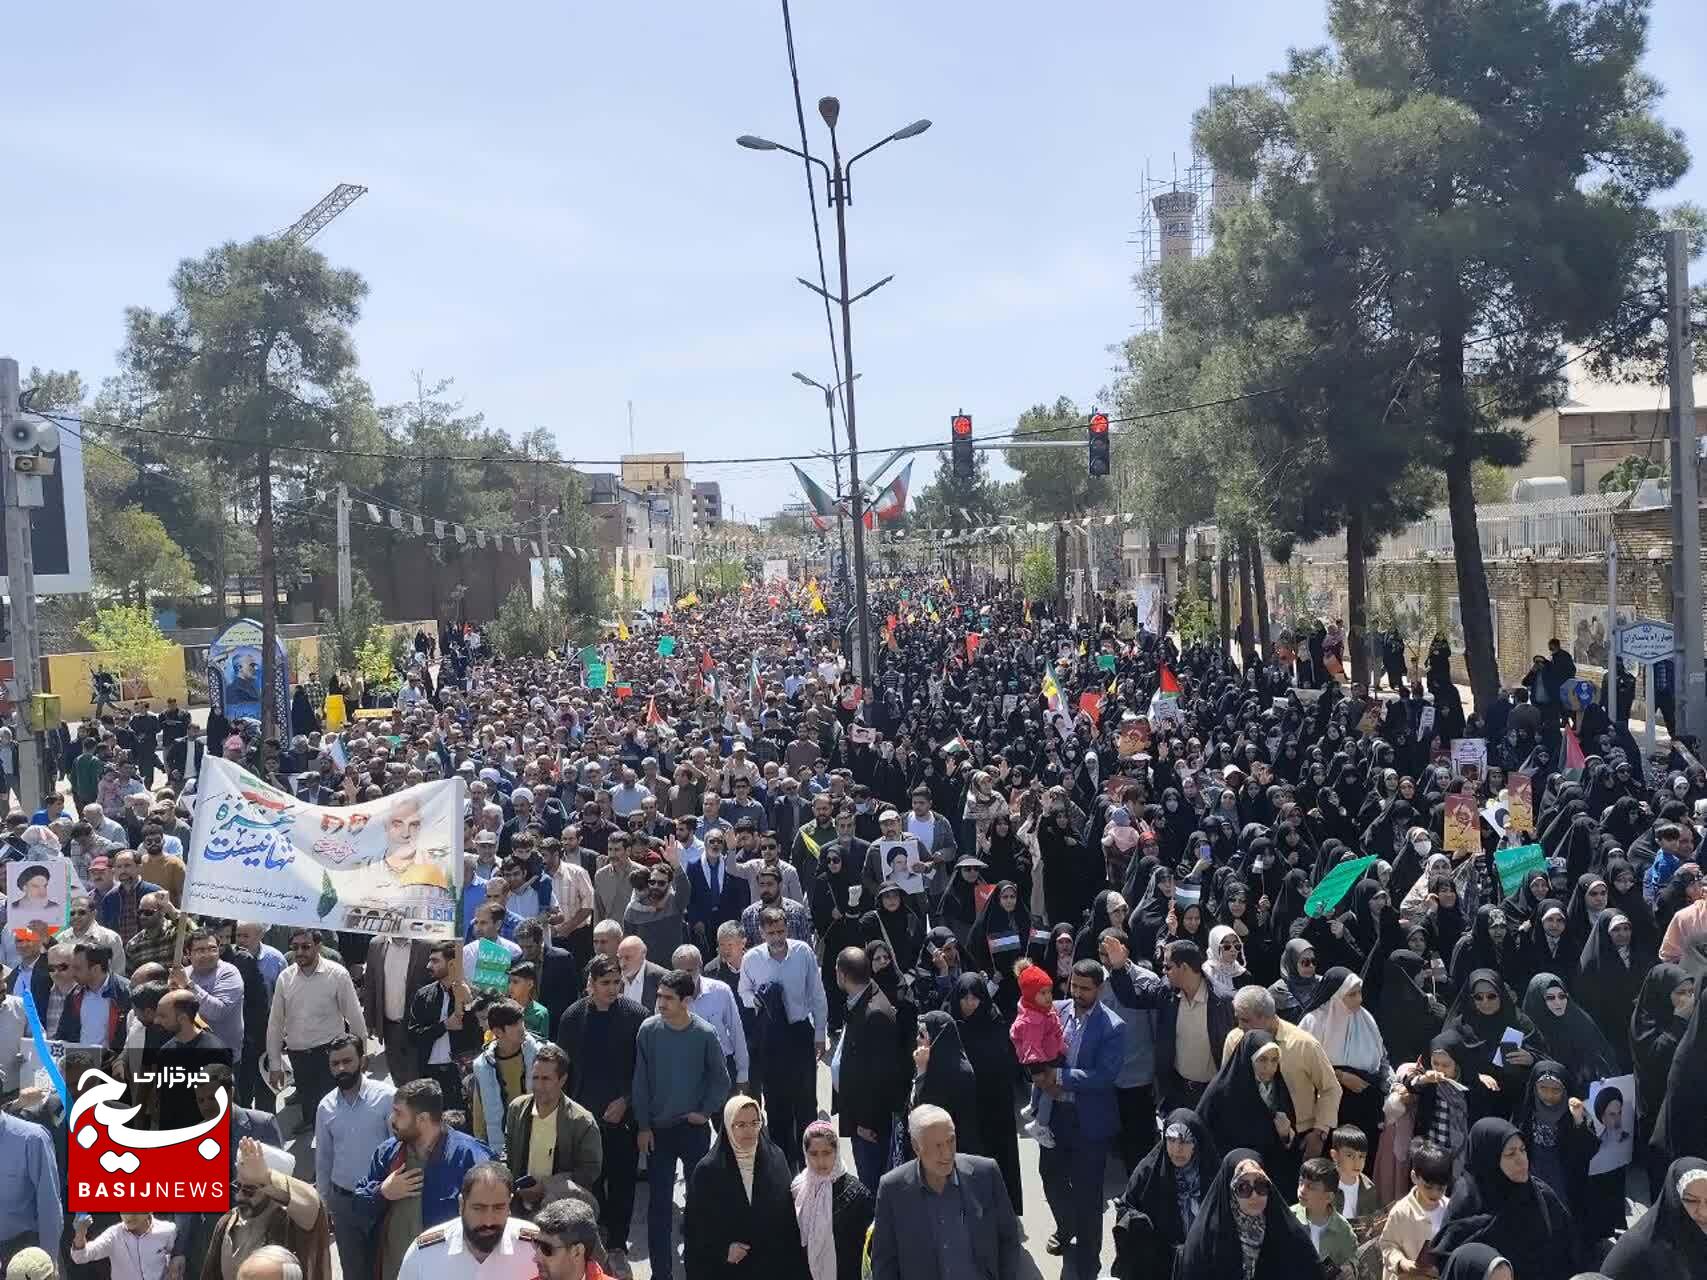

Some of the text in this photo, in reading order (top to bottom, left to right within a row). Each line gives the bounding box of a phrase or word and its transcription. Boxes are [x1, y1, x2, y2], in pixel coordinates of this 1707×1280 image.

[215, 802, 297, 831] غزه
[203, 832, 274, 867] نیست
[264, 837, 297, 872] تنها
